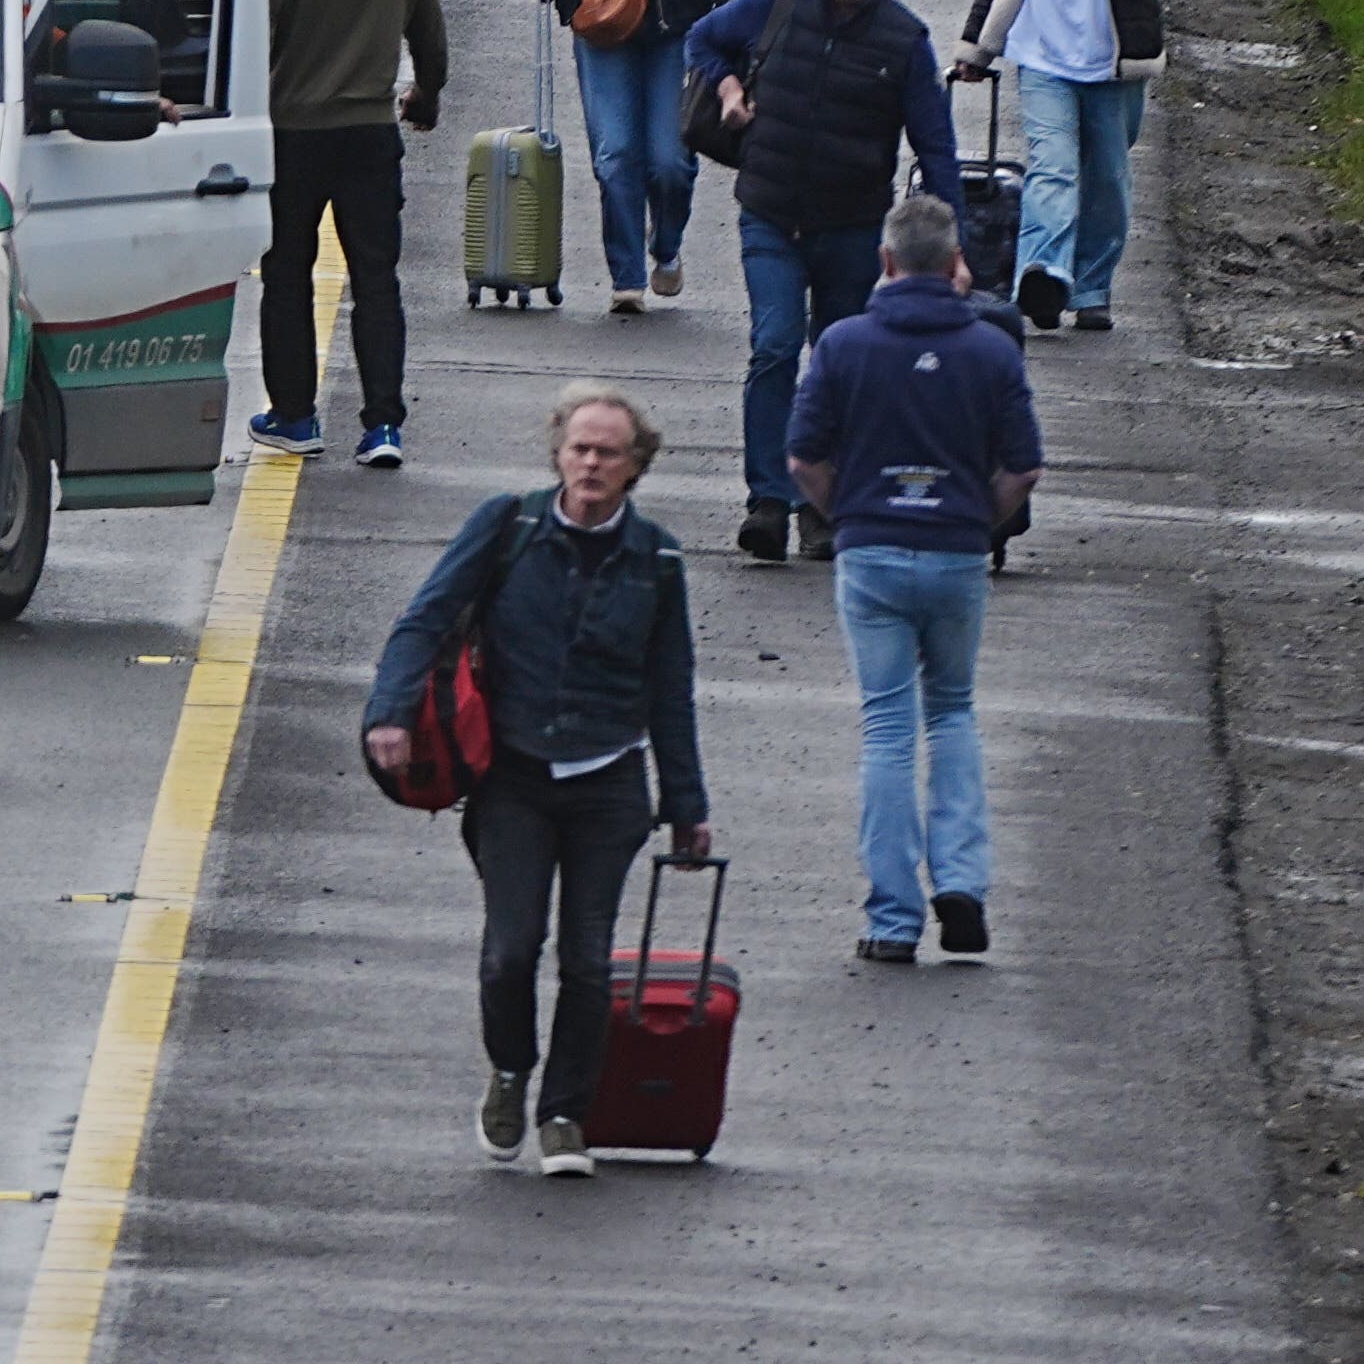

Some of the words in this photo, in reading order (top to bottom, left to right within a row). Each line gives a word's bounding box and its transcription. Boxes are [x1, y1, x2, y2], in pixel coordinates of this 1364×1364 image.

[65, 343, 95, 374] 01
[98, 338, 142, 370] 419
[144, 336, 175, 367] 06
[178, 334, 207, 363] 75
